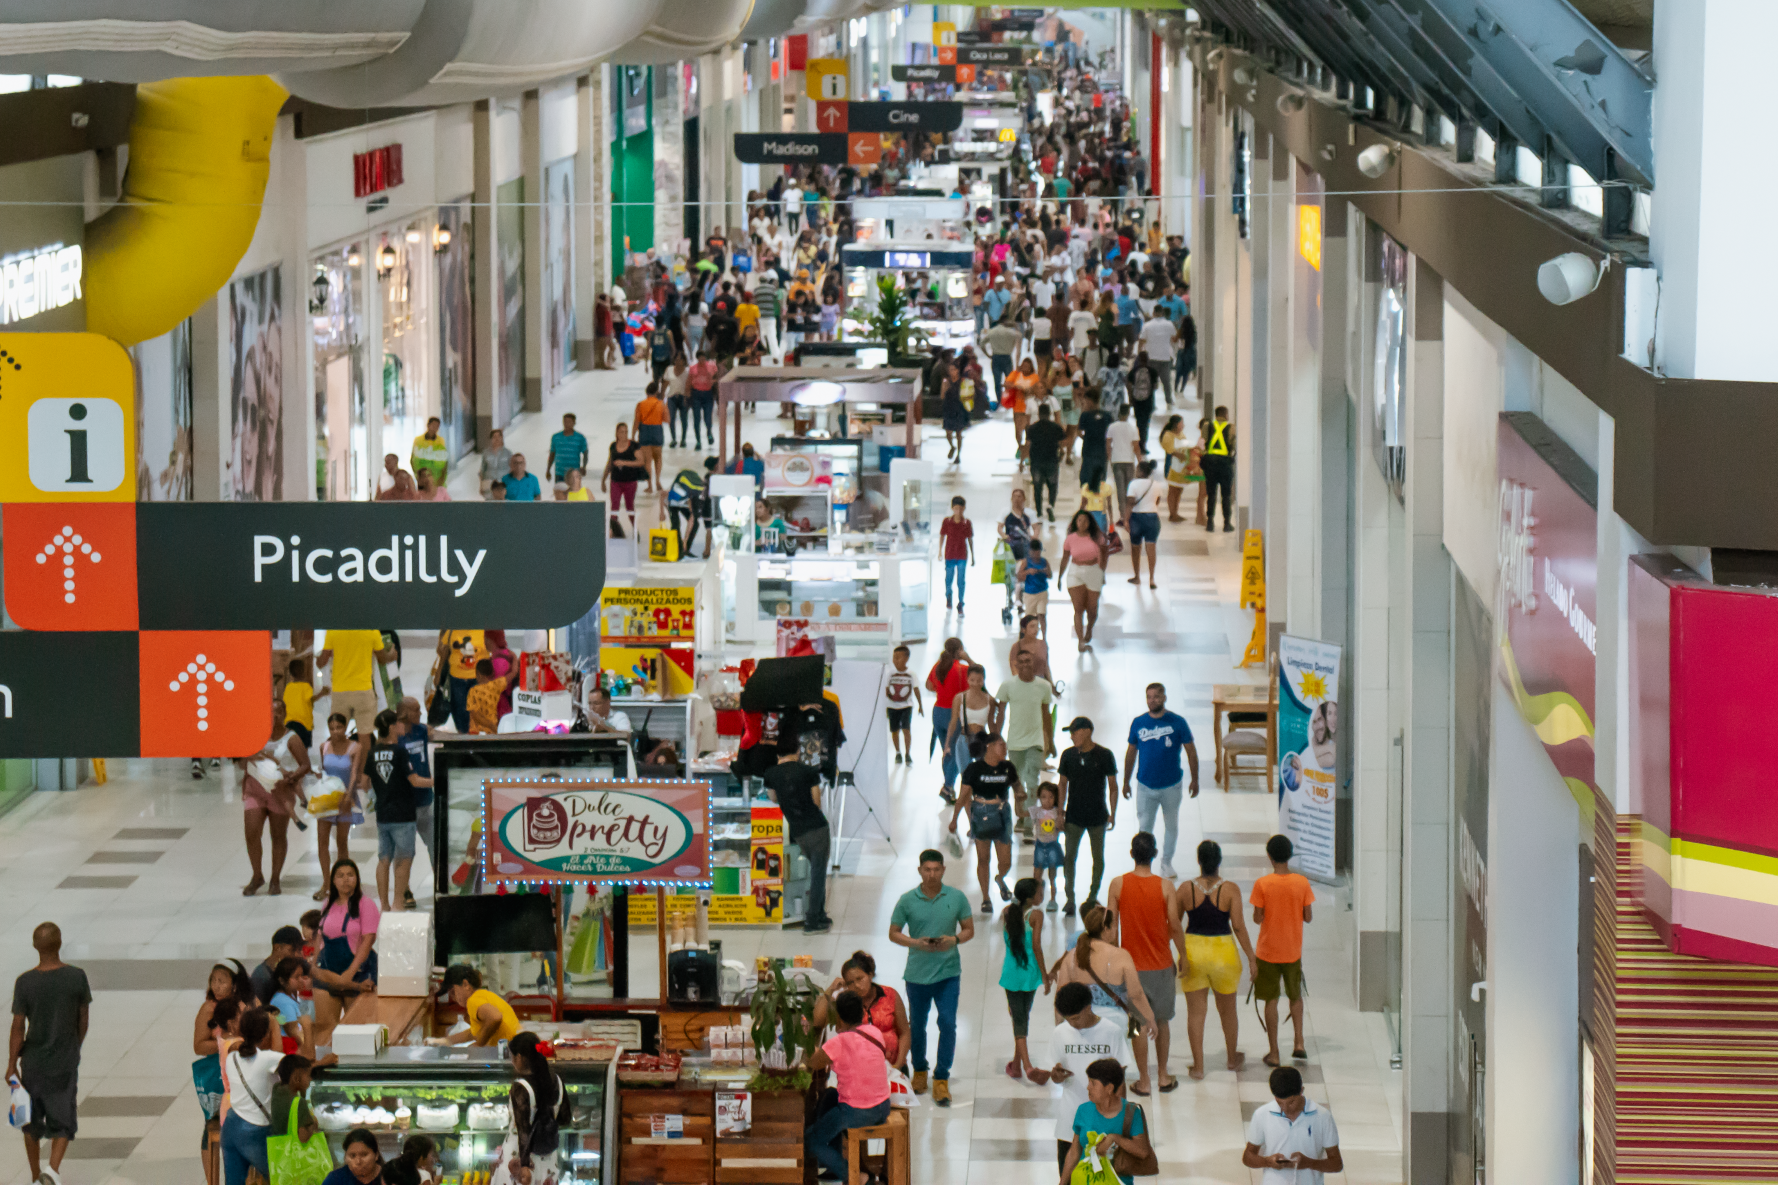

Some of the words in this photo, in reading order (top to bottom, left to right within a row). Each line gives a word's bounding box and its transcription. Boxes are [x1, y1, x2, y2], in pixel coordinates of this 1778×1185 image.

[888, 110, 920, 124] Cine
[763, 141, 819, 156] Madison
[0, 244, 82, 325] REMIER
[254, 535, 487, 597] Picadilly
[618, 588, 679, 597] PRODUCTOS
[604, 597, 693, 605] PERSONALIZADOS
[517, 692, 542, 705] COPIAS
[1138, 725, 1174, 740] Dodgers
[563, 791, 624, 818] Dulce
[570, 855, 580, 864] El
[609, 855, 623, 864] de
[595, 863, 632, 872] Dulces
[1064, 1044, 1111, 1054] BLESSED
